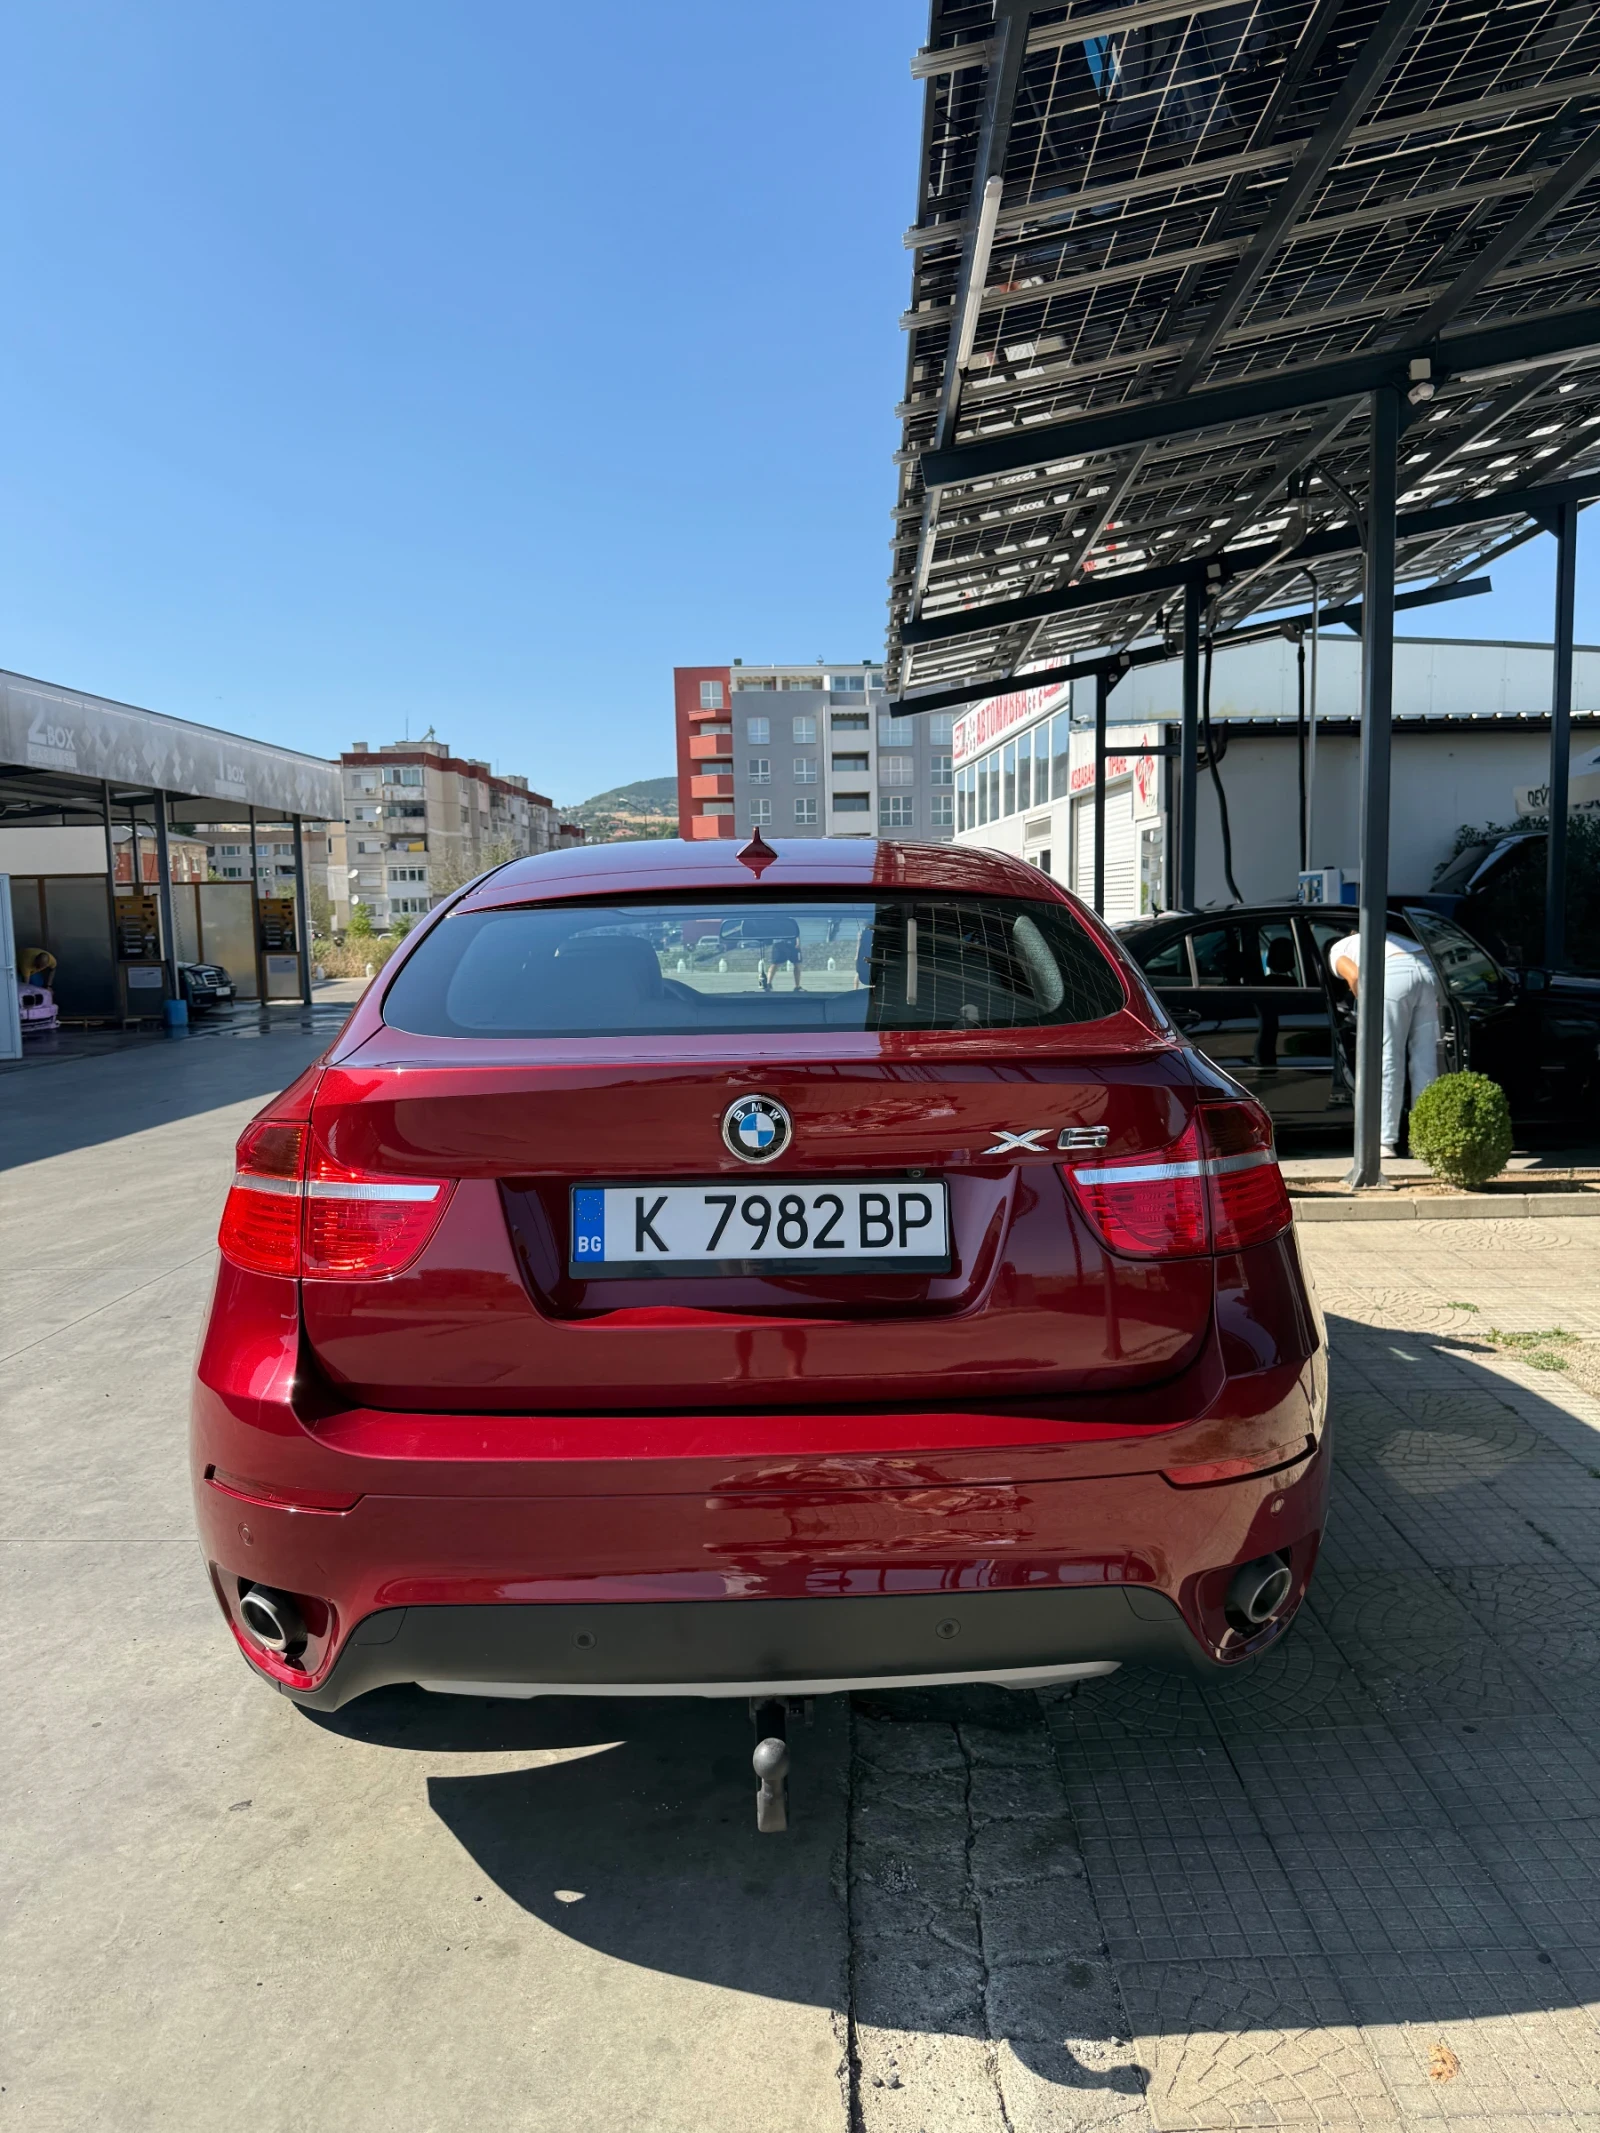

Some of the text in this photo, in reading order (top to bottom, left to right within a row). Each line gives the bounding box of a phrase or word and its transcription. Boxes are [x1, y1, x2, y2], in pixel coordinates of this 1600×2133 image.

[47, 724, 76, 751] BOX
[733, 1102, 781, 1122] BMW
[980, 1125, 1110, 1155] X6
[635, 1196, 670, 1252] K
[577, 1236, 602, 1253] BG
